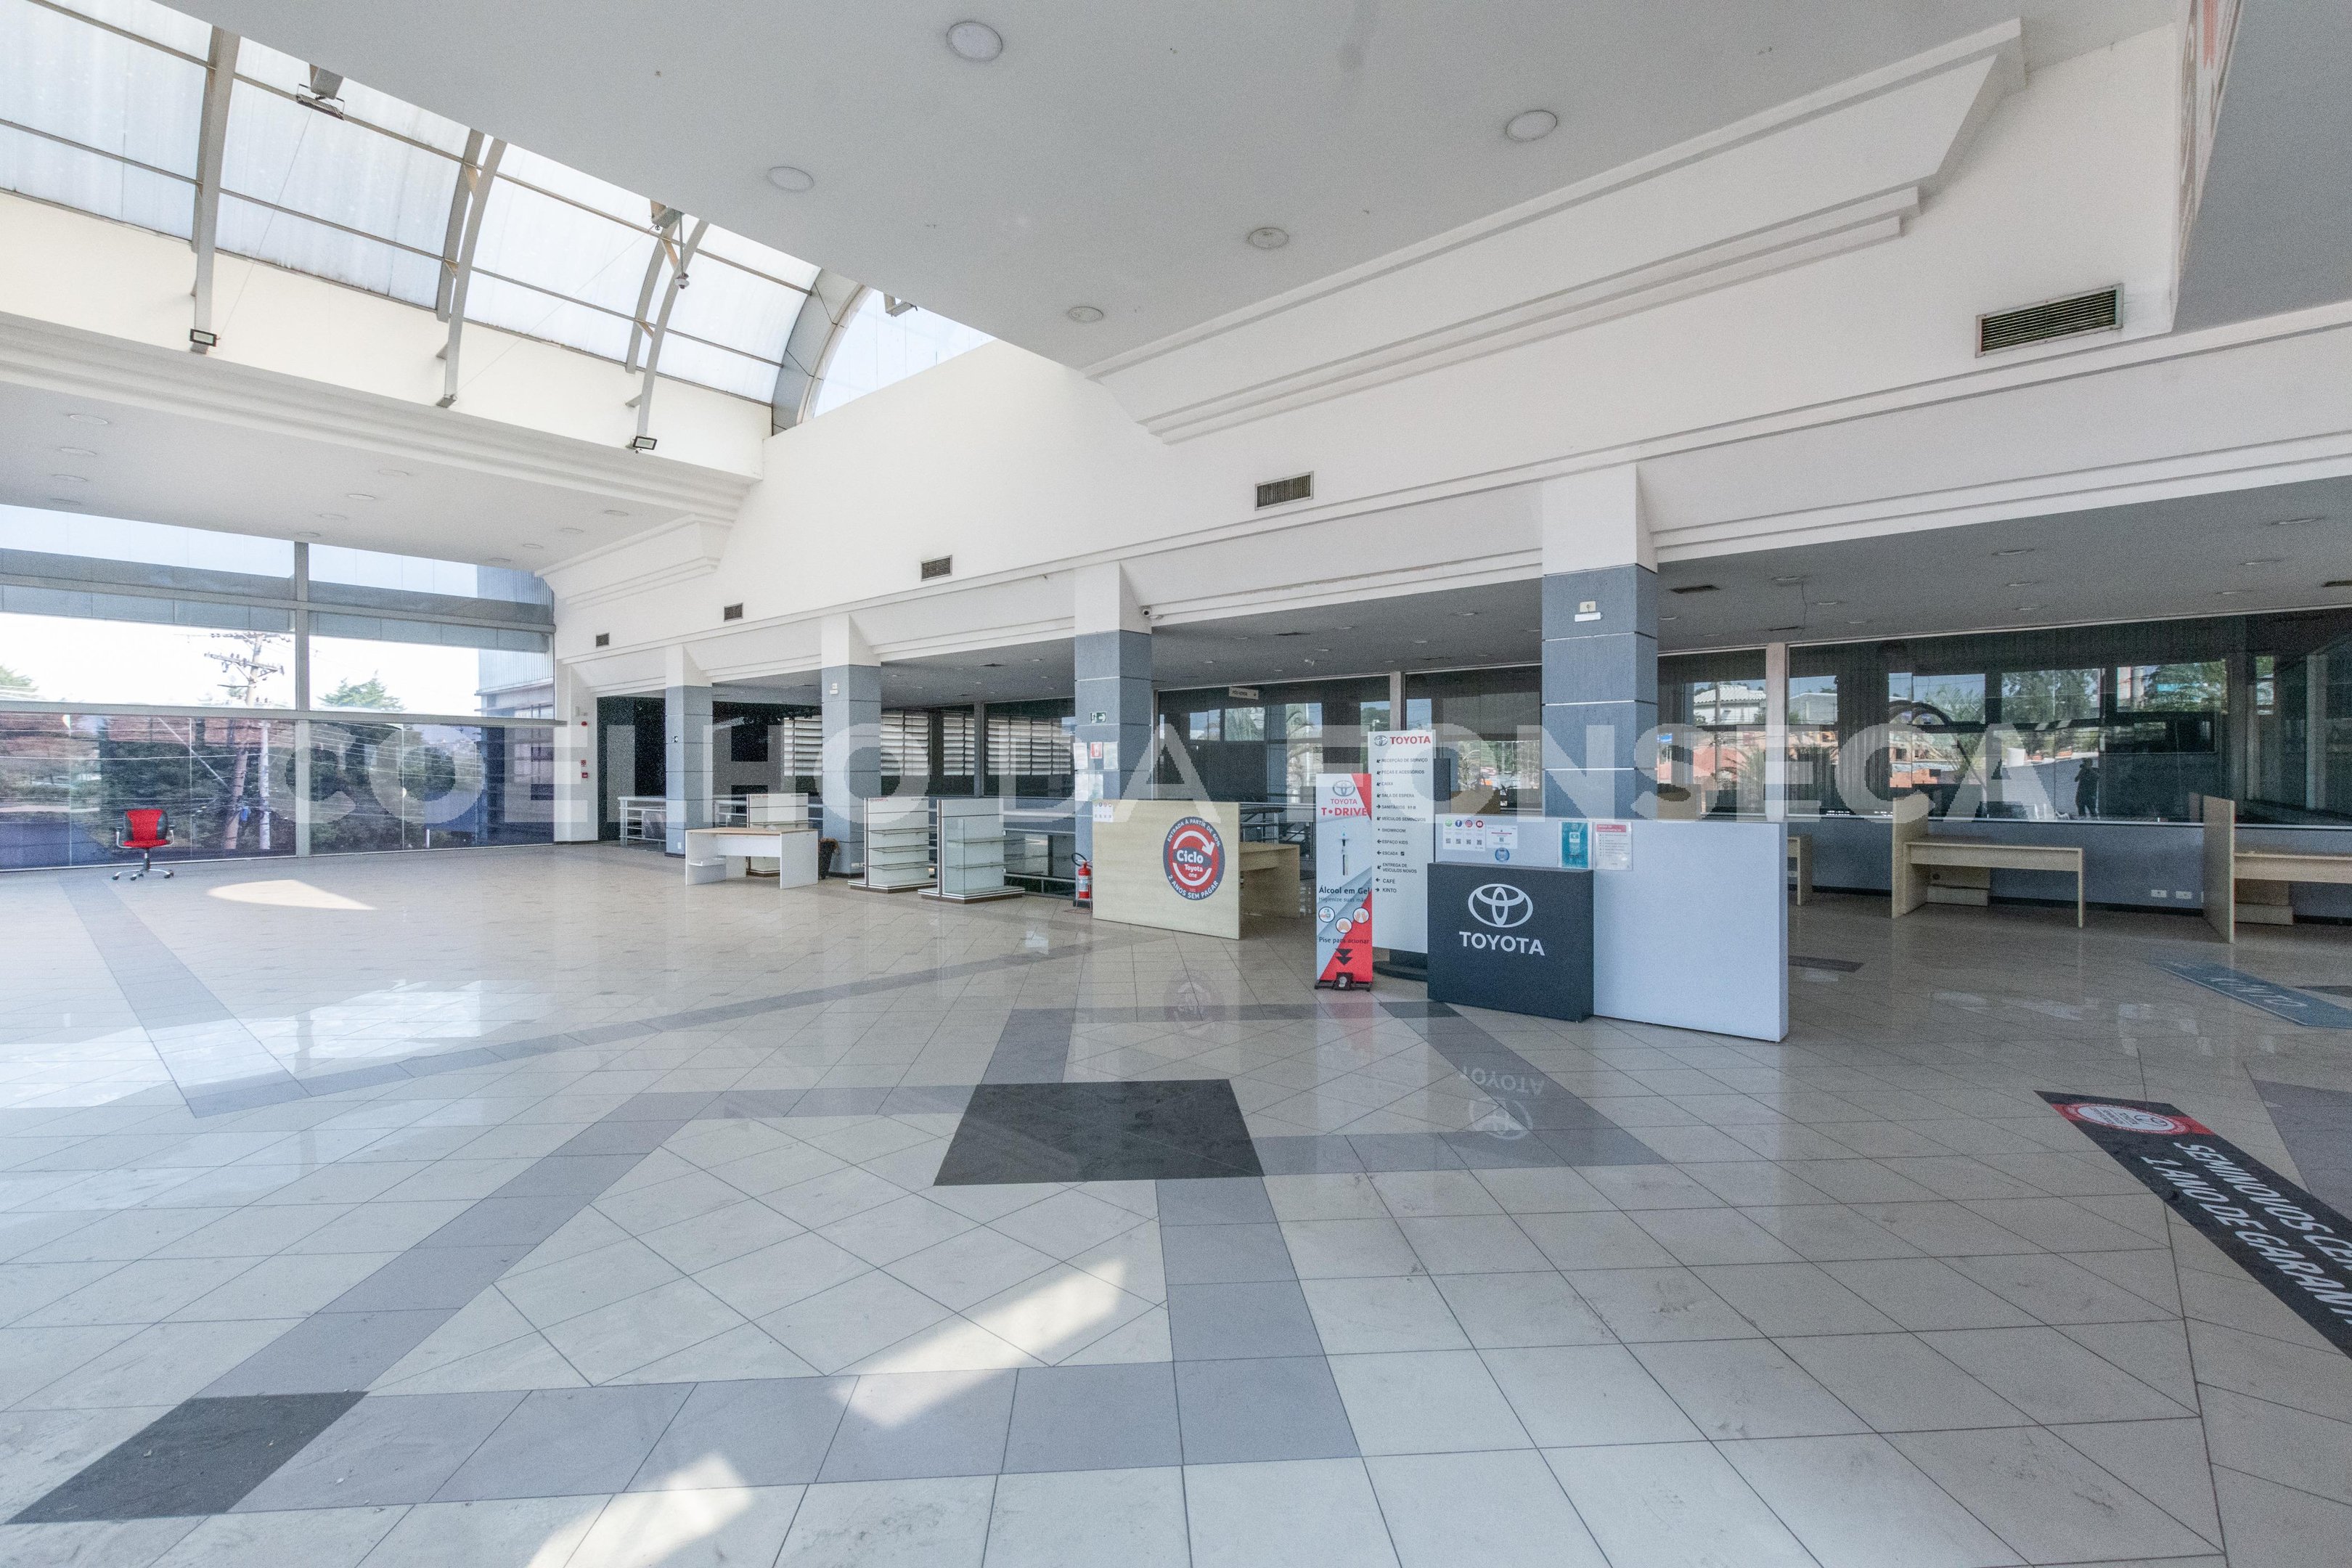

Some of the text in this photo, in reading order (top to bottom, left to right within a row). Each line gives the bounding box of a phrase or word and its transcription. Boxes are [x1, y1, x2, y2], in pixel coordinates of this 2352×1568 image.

[1389, 736, 1431, 745] TOYOTA
[1167, 821, 1185, 842] ENTRADA
[1177, 849, 1204, 864] Ciclo
[1184, 864, 1204, 873] Toyota
[1172, 881, 1186, 896] ANOS
[1201, 880, 1220, 898] PAGAR
[1318, 886, 1342, 894] Álcool
[1459, 931, 1545, 956] TOYOTA
[2140, 1156, 2183, 1166] 1
[2153, 1167, 2230, 1202] ANO
[2173, 1142, 2335, 1234] SEMINOVOS
[2198, 1203, 2269, 1231] DE
